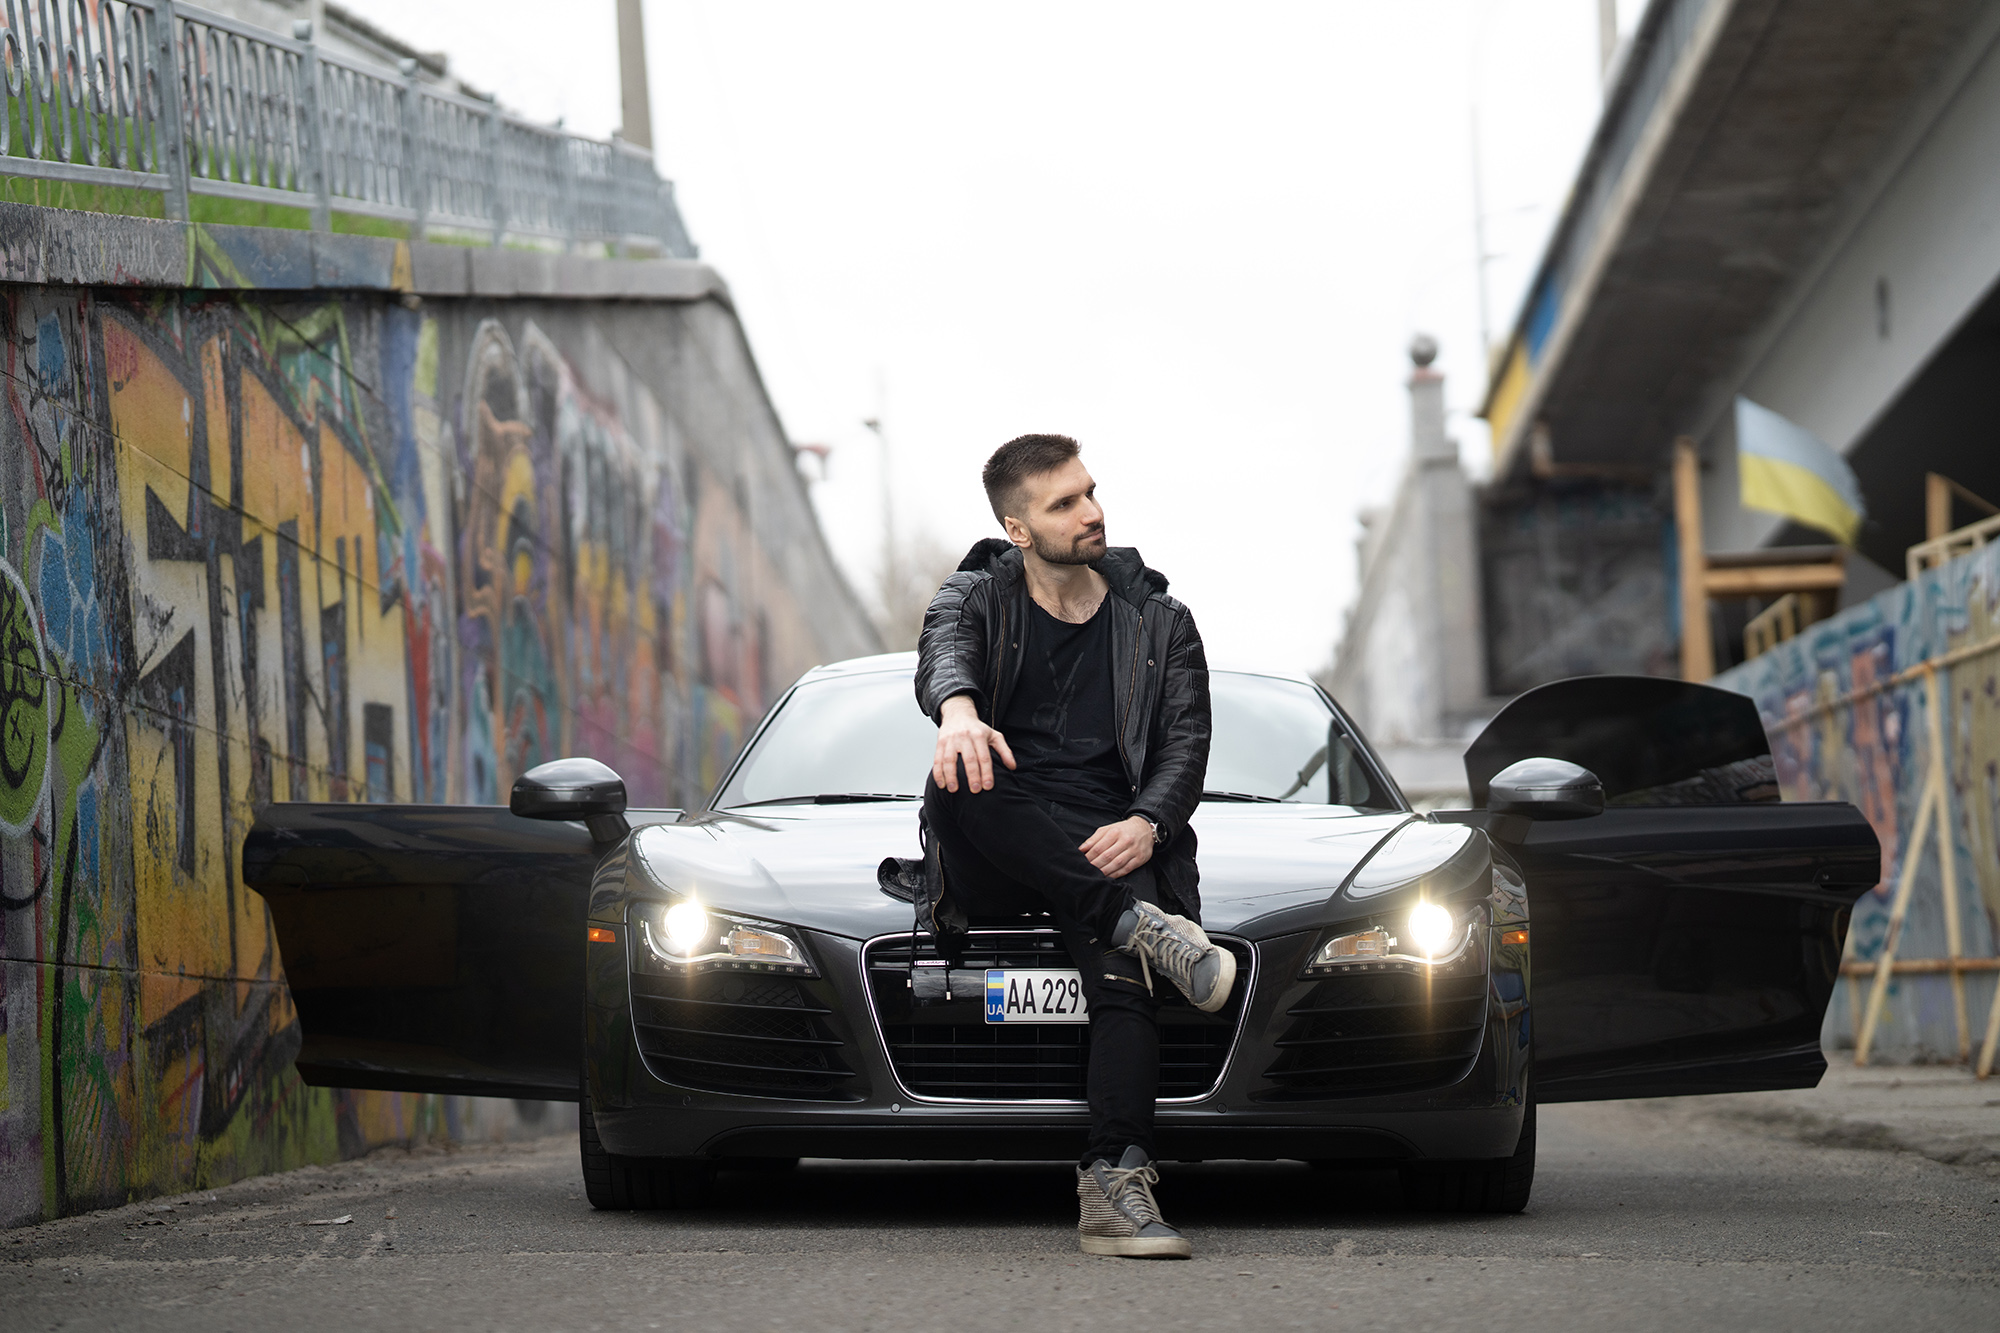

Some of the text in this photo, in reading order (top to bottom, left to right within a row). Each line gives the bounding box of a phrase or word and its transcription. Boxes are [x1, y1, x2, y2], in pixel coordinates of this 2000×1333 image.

[1006, 978, 1088, 1014] AA 229
[987, 1004, 1004, 1015] UA
